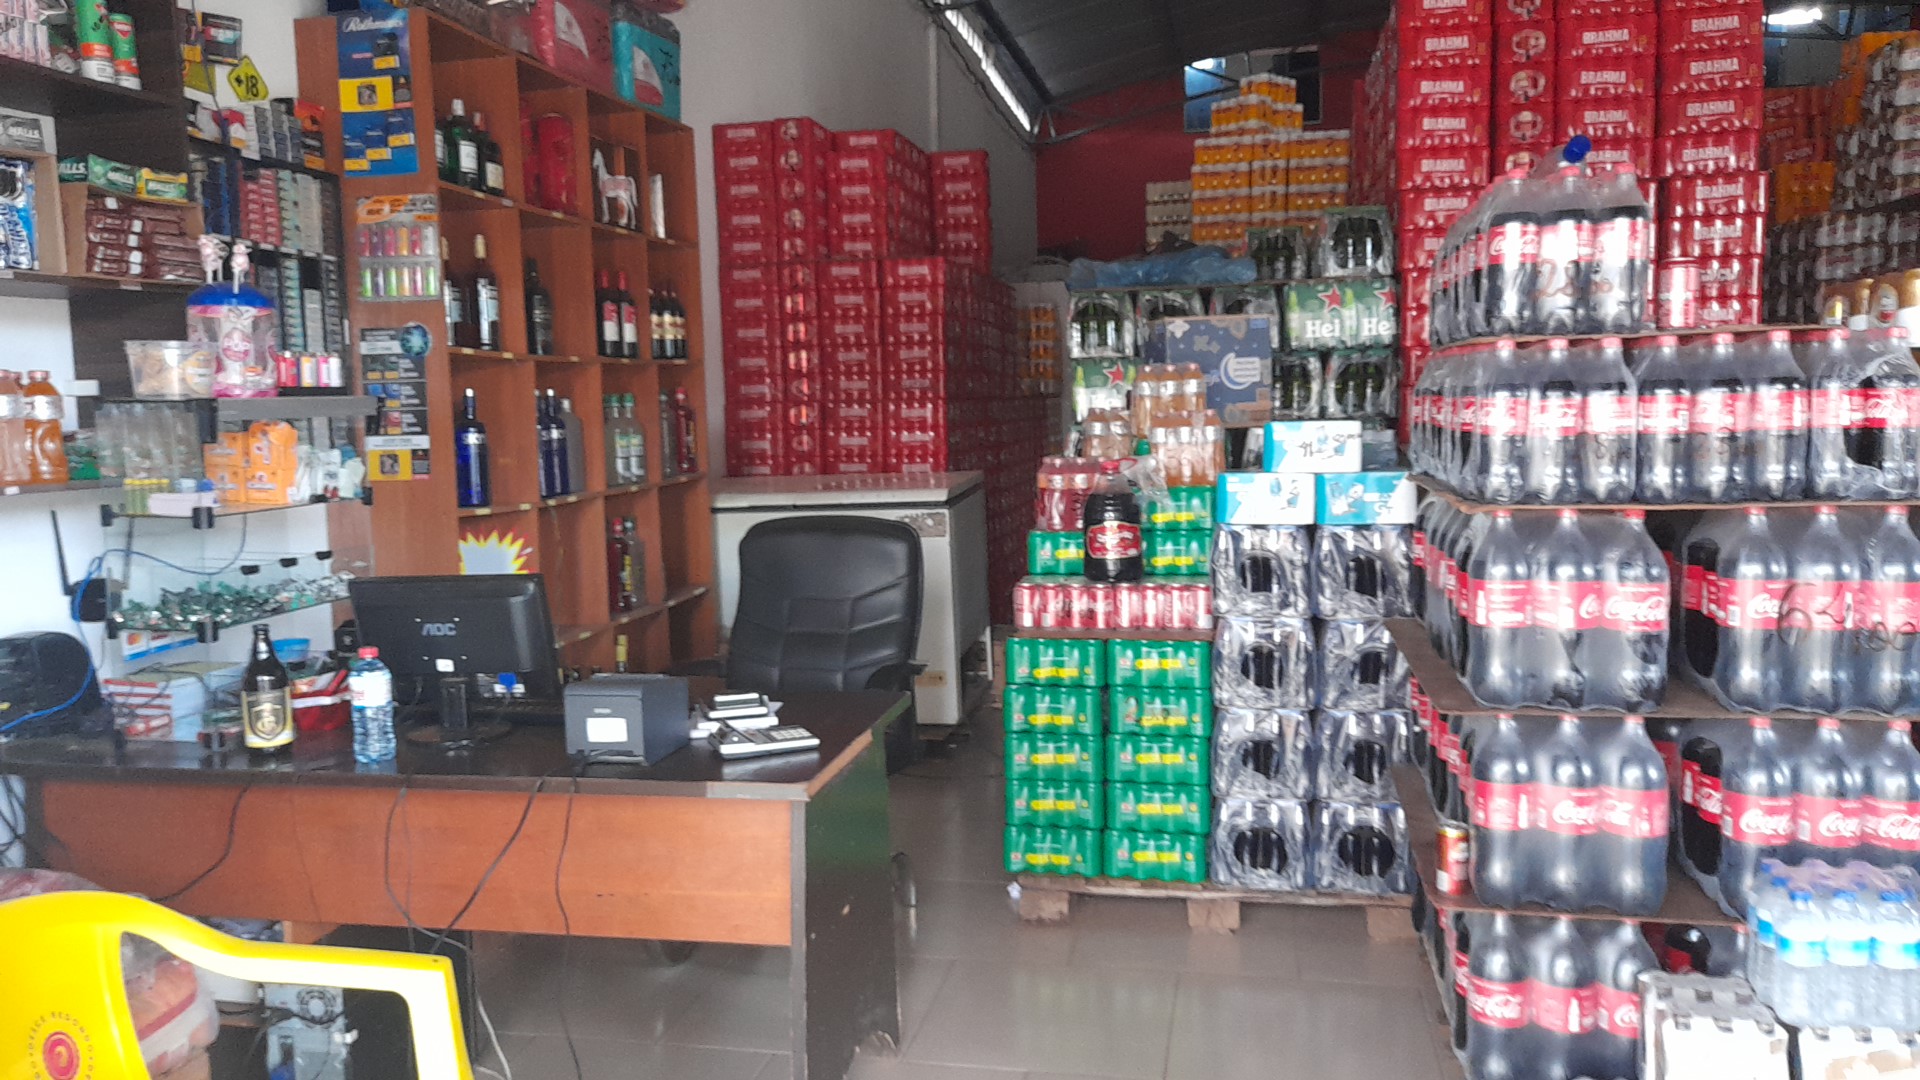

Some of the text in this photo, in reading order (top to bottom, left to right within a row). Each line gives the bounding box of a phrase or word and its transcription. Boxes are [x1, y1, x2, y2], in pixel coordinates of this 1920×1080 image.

[1691, 15, 1740, 33] BRAHMA
[1425, 35, 1469, 52] BRAHMA
[1582, 28, 1629, 45] BRAHMA
[1690, 57, 1739, 76] BRAHMA
[1581, 71, 1626, 85] BRAHMA
[1421, 81, 1464, 94] BRAHMA
[1584, 109, 1629, 124] BRAHMA
[1686, 100, 1735, 117] BRAHMA
[1423, 117, 1467, 131] BRAHMA
[1421, 158, 1466, 172] BRAHMA
[1696, 182, 1744, 199] BRAHMA
[1424, 197, 1468, 211] BRAHMA
